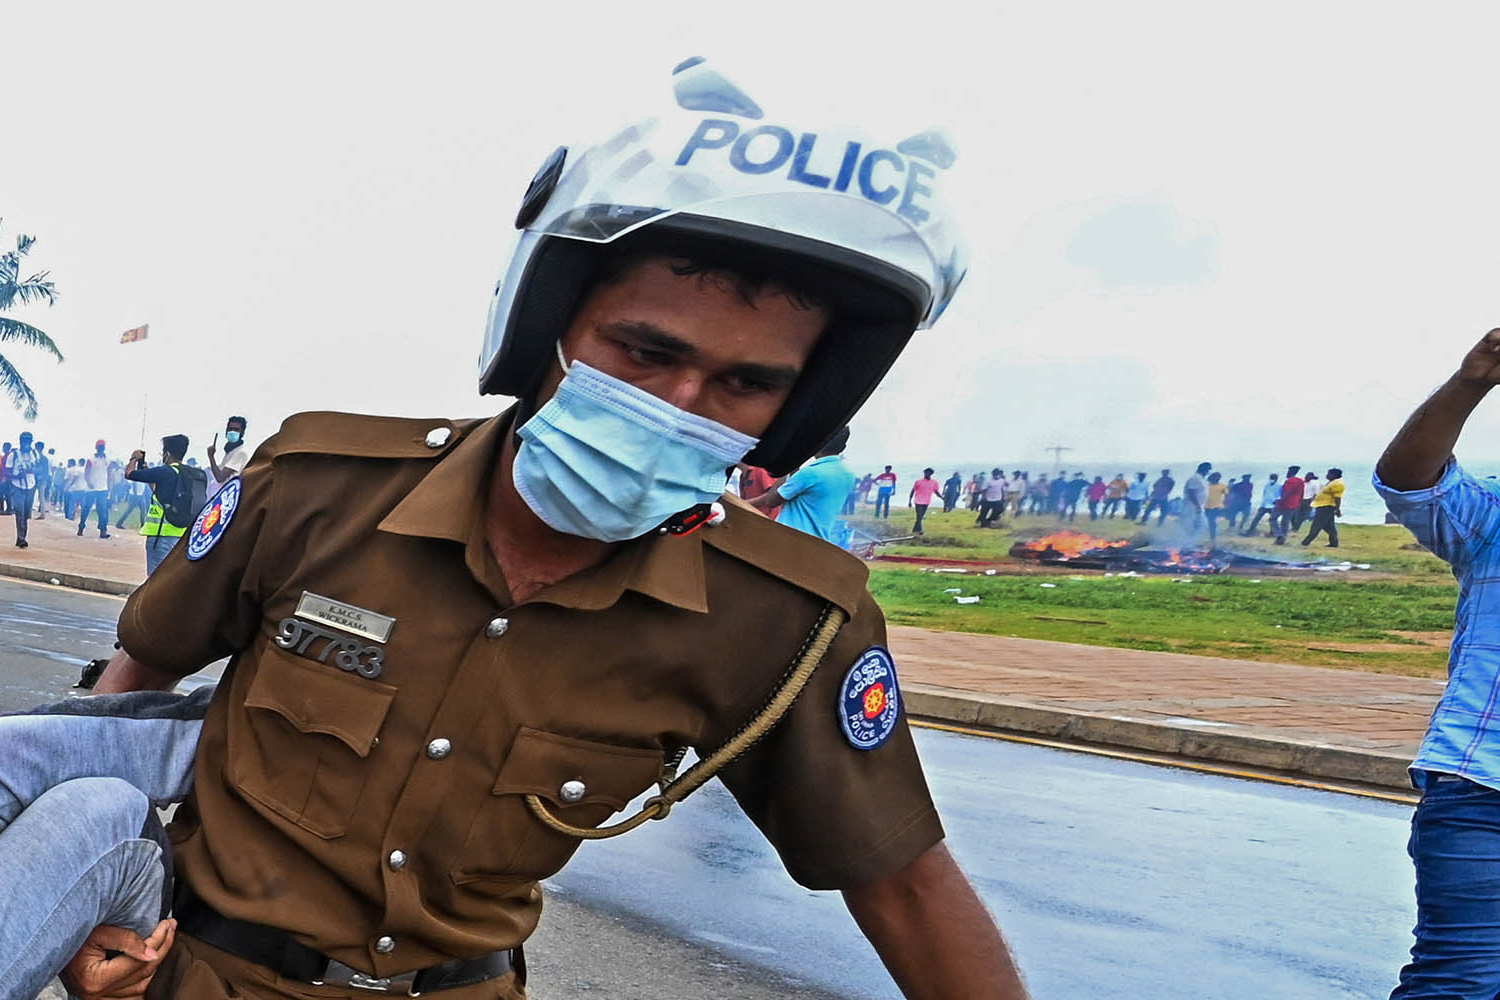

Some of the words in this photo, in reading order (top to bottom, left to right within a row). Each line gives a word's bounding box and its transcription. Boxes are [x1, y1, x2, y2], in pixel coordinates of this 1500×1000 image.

[674, 119, 936, 225] POLICE
[318, 611, 368, 632] WICKRAMA
[275, 617, 385, 679] 97783
[849, 714, 875, 740] POLICE
